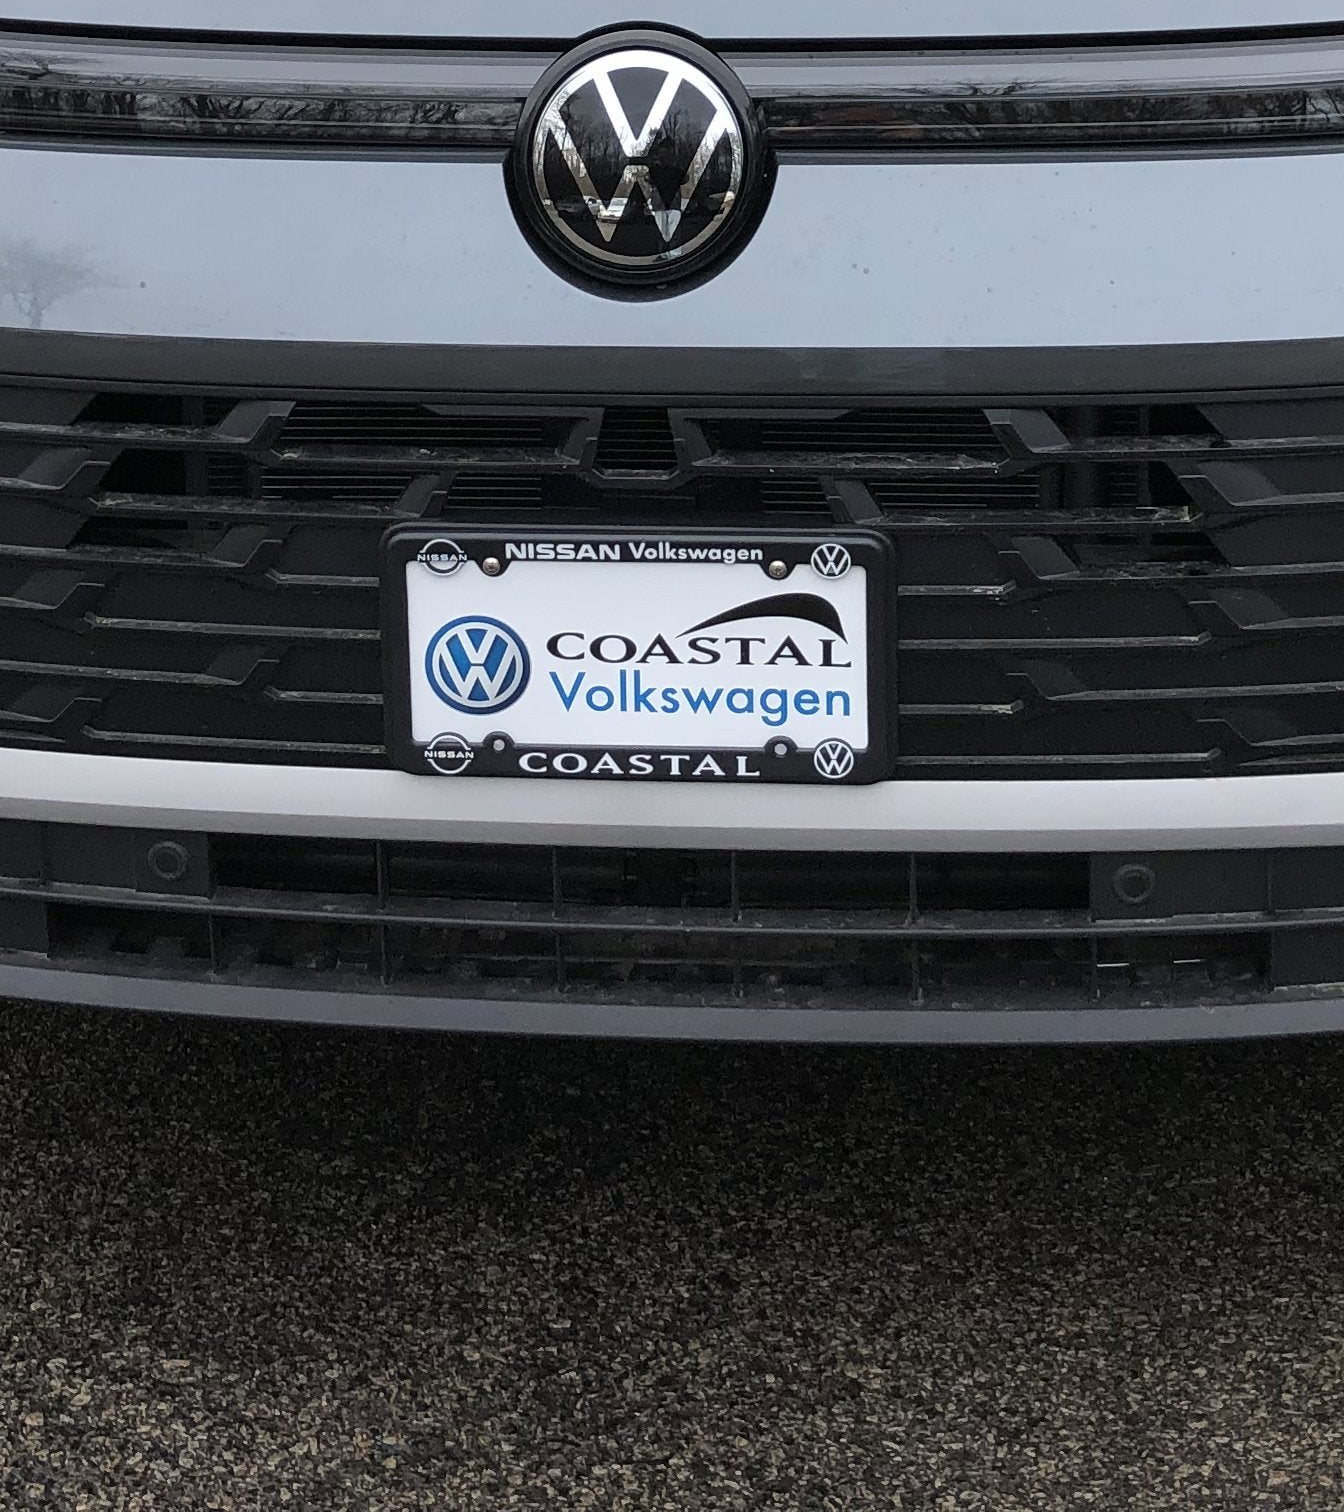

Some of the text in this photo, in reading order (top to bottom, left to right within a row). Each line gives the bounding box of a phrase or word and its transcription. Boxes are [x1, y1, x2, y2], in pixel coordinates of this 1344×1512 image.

[540, 58, 734, 247] VW
[417, 553, 468, 562] NISSAN
[505, 541, 764, 565] NISSAN Volkswagen
[813, 545, 849, 577] VW
[433, 623, 523, 707] VW
[546, 631, 853, 668] COASTAL
[549, 669, 851, 727] Volkswagen
[423, 750, 475, 760] NISSAN
[518, 751, 761, 777] COASTAL
[816, 743, 852, 776] VW
